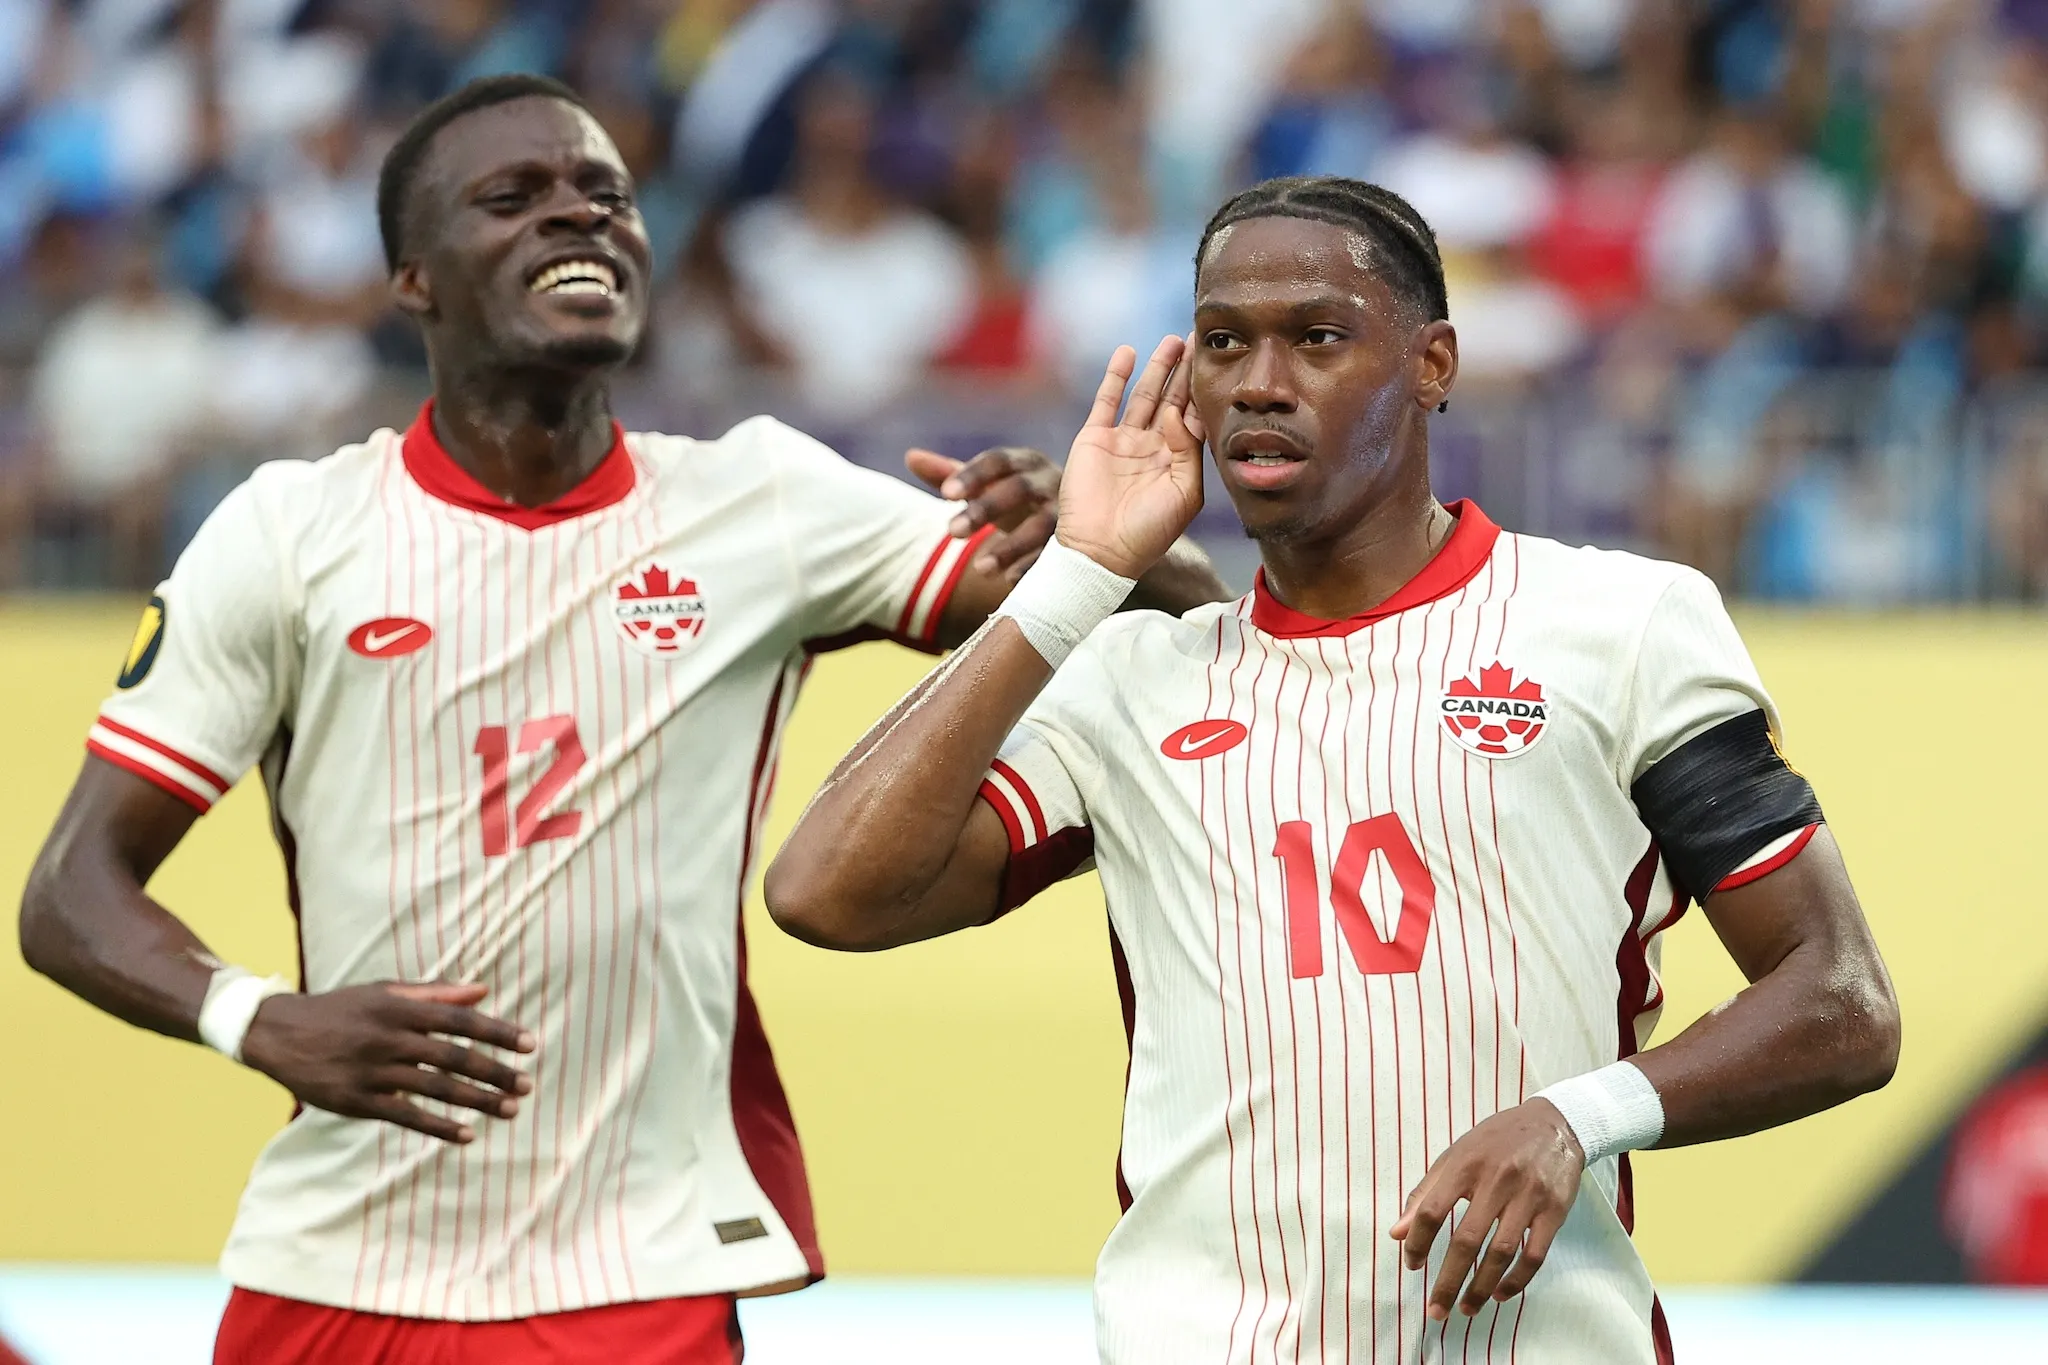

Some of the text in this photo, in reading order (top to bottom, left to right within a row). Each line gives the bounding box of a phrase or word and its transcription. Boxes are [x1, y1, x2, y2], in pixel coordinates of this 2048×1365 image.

[1441, 699, 1546, 720] CANADA
[474, 714, 586, 858] 12
[1272, 812, 1436, 979] 10
